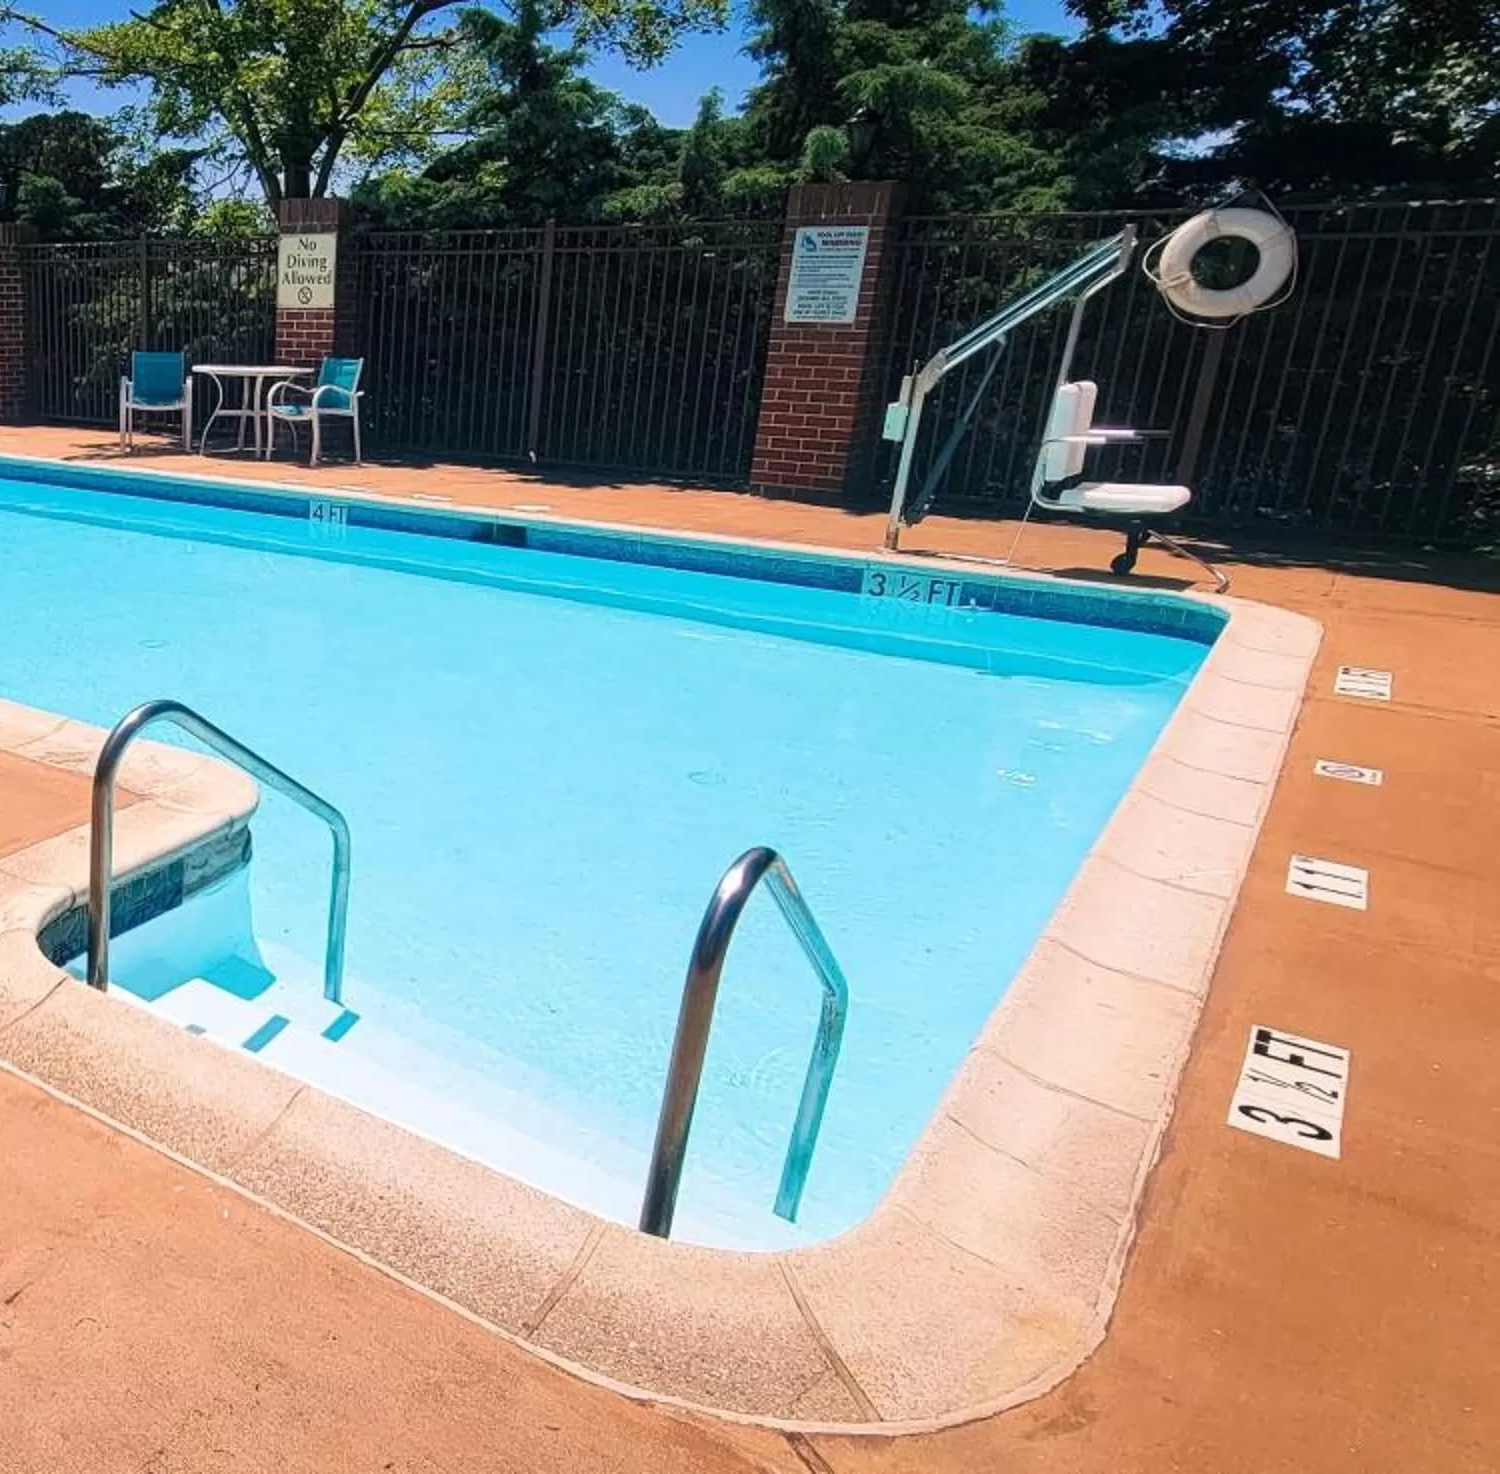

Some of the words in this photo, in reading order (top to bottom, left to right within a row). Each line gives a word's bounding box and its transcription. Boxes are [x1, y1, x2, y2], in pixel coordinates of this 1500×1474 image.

[299, 237, 317, 251] No
[287, 253, 328, 273] Diving
[282, 269, 332, 285] Allowed
[312, 503, 325, 523] 4
[329, 505, 348, 525] FT
[867, 572, 887, 596] 3
[927, 579, 960, 606] FT
[1252, 1028, 1345, 1079] FT
[1237, 1104, 1334, 1141] 3
